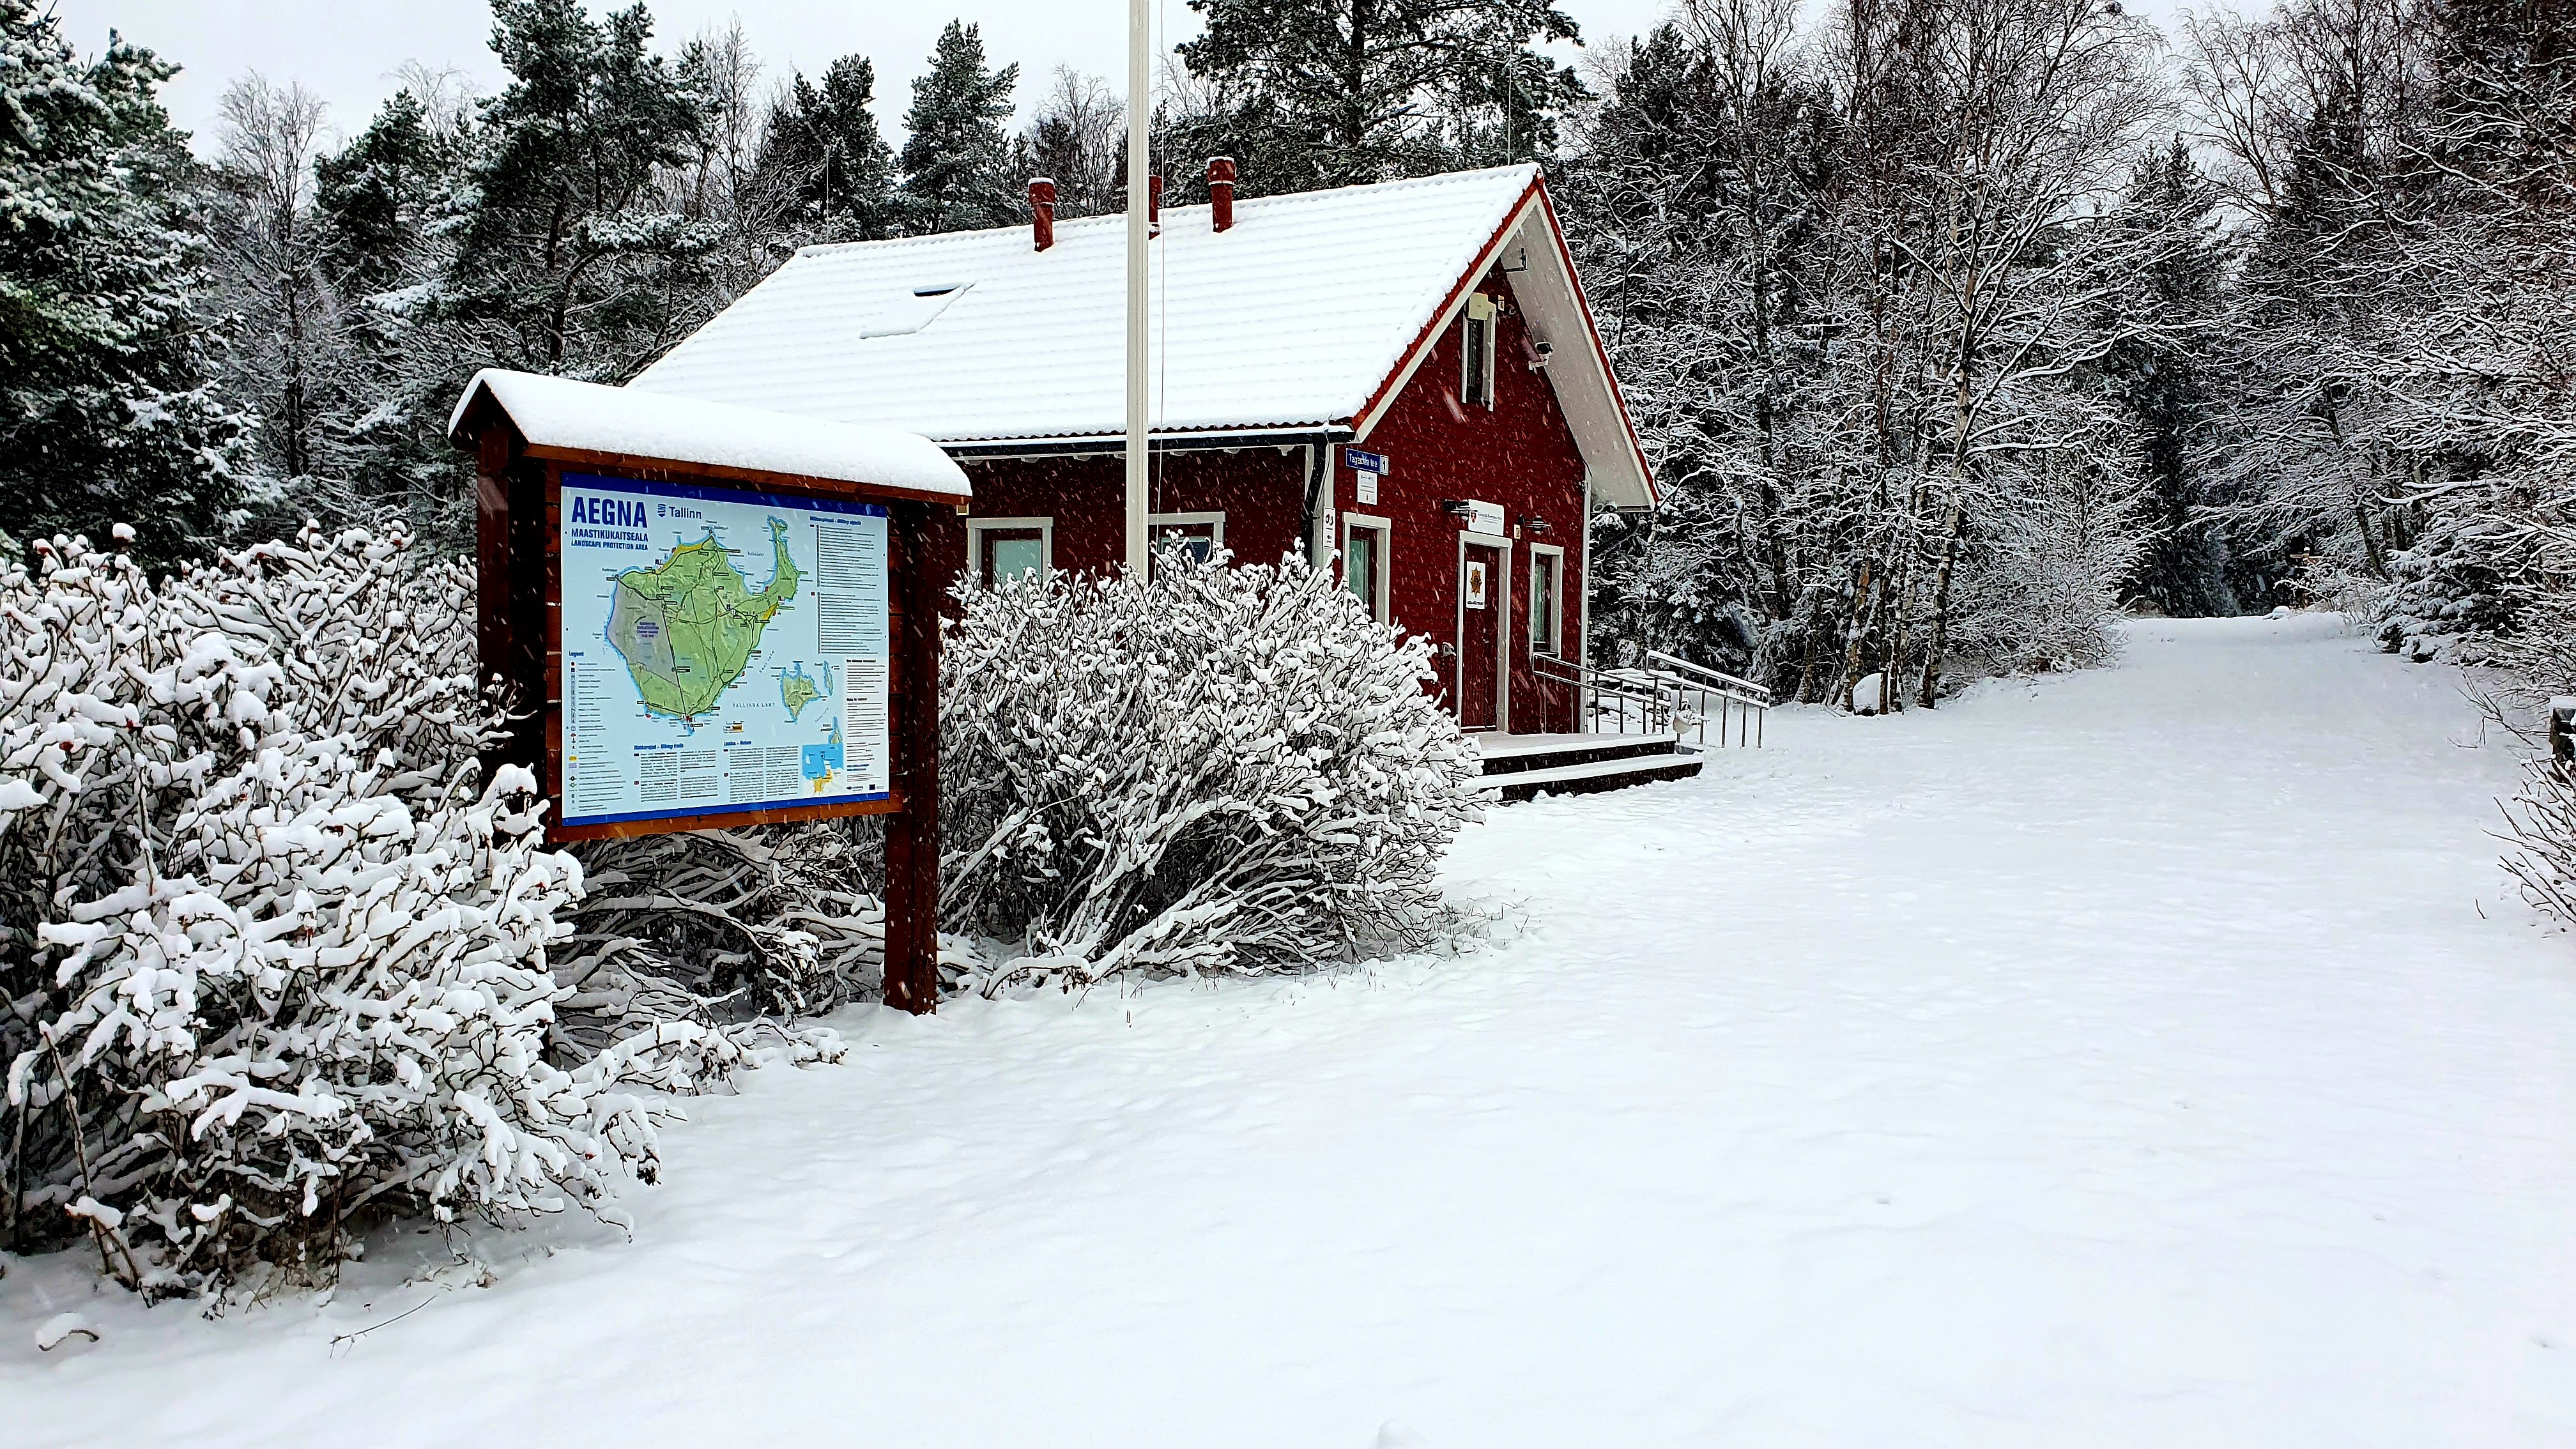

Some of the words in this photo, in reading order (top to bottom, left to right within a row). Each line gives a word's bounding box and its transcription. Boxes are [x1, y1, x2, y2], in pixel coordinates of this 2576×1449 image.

[1383, 459, 1386, 471] 1
[571, 496, 648, 528] AEGNA
[668, 506, 702, 519] Tallinn
[571, 528, 648, 542] MAASTIKUKAITSEALA
[571, 539, 602, 548] LANDSCAPE
[602, 540, 634, 550] PROTECTION
